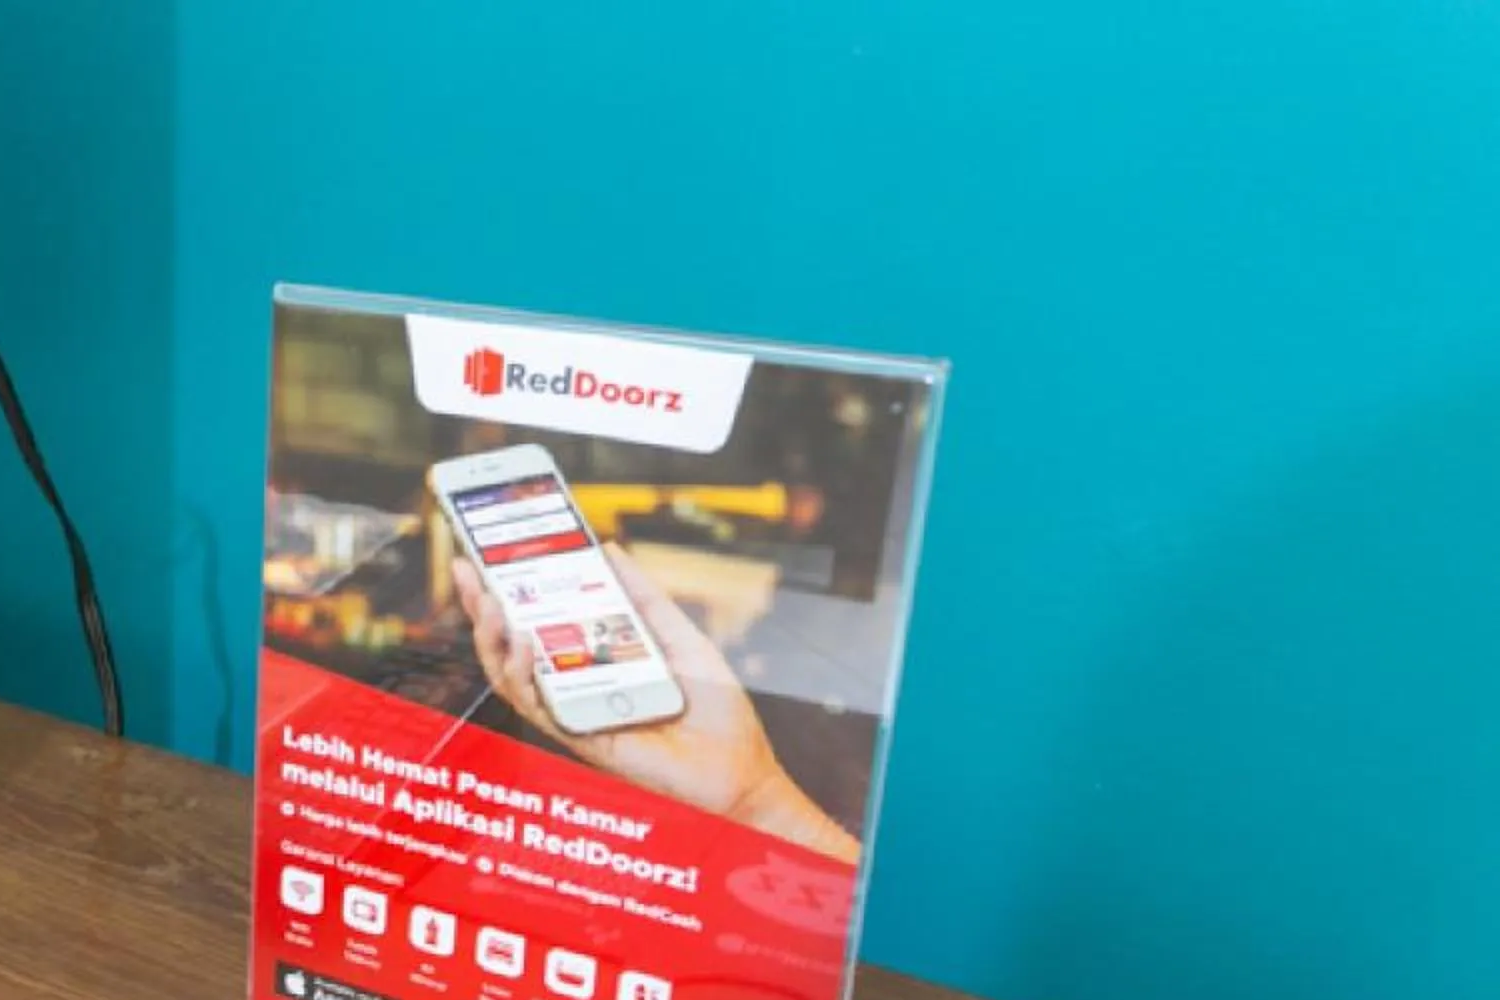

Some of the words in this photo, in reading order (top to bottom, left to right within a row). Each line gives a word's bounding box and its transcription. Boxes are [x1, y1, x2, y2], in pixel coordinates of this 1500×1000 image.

[506, 362, 683, 412] RedDoorz
[281, 762, 385, 807] melalui
[393, 787, 515, 842] Aplikasi
[282, 724, 356, 764] Lebih
[361, 744, 450, 789] Hemat
[457, 770, 544, 814] Pesan
[551, 795, 653, 841] Kamar
